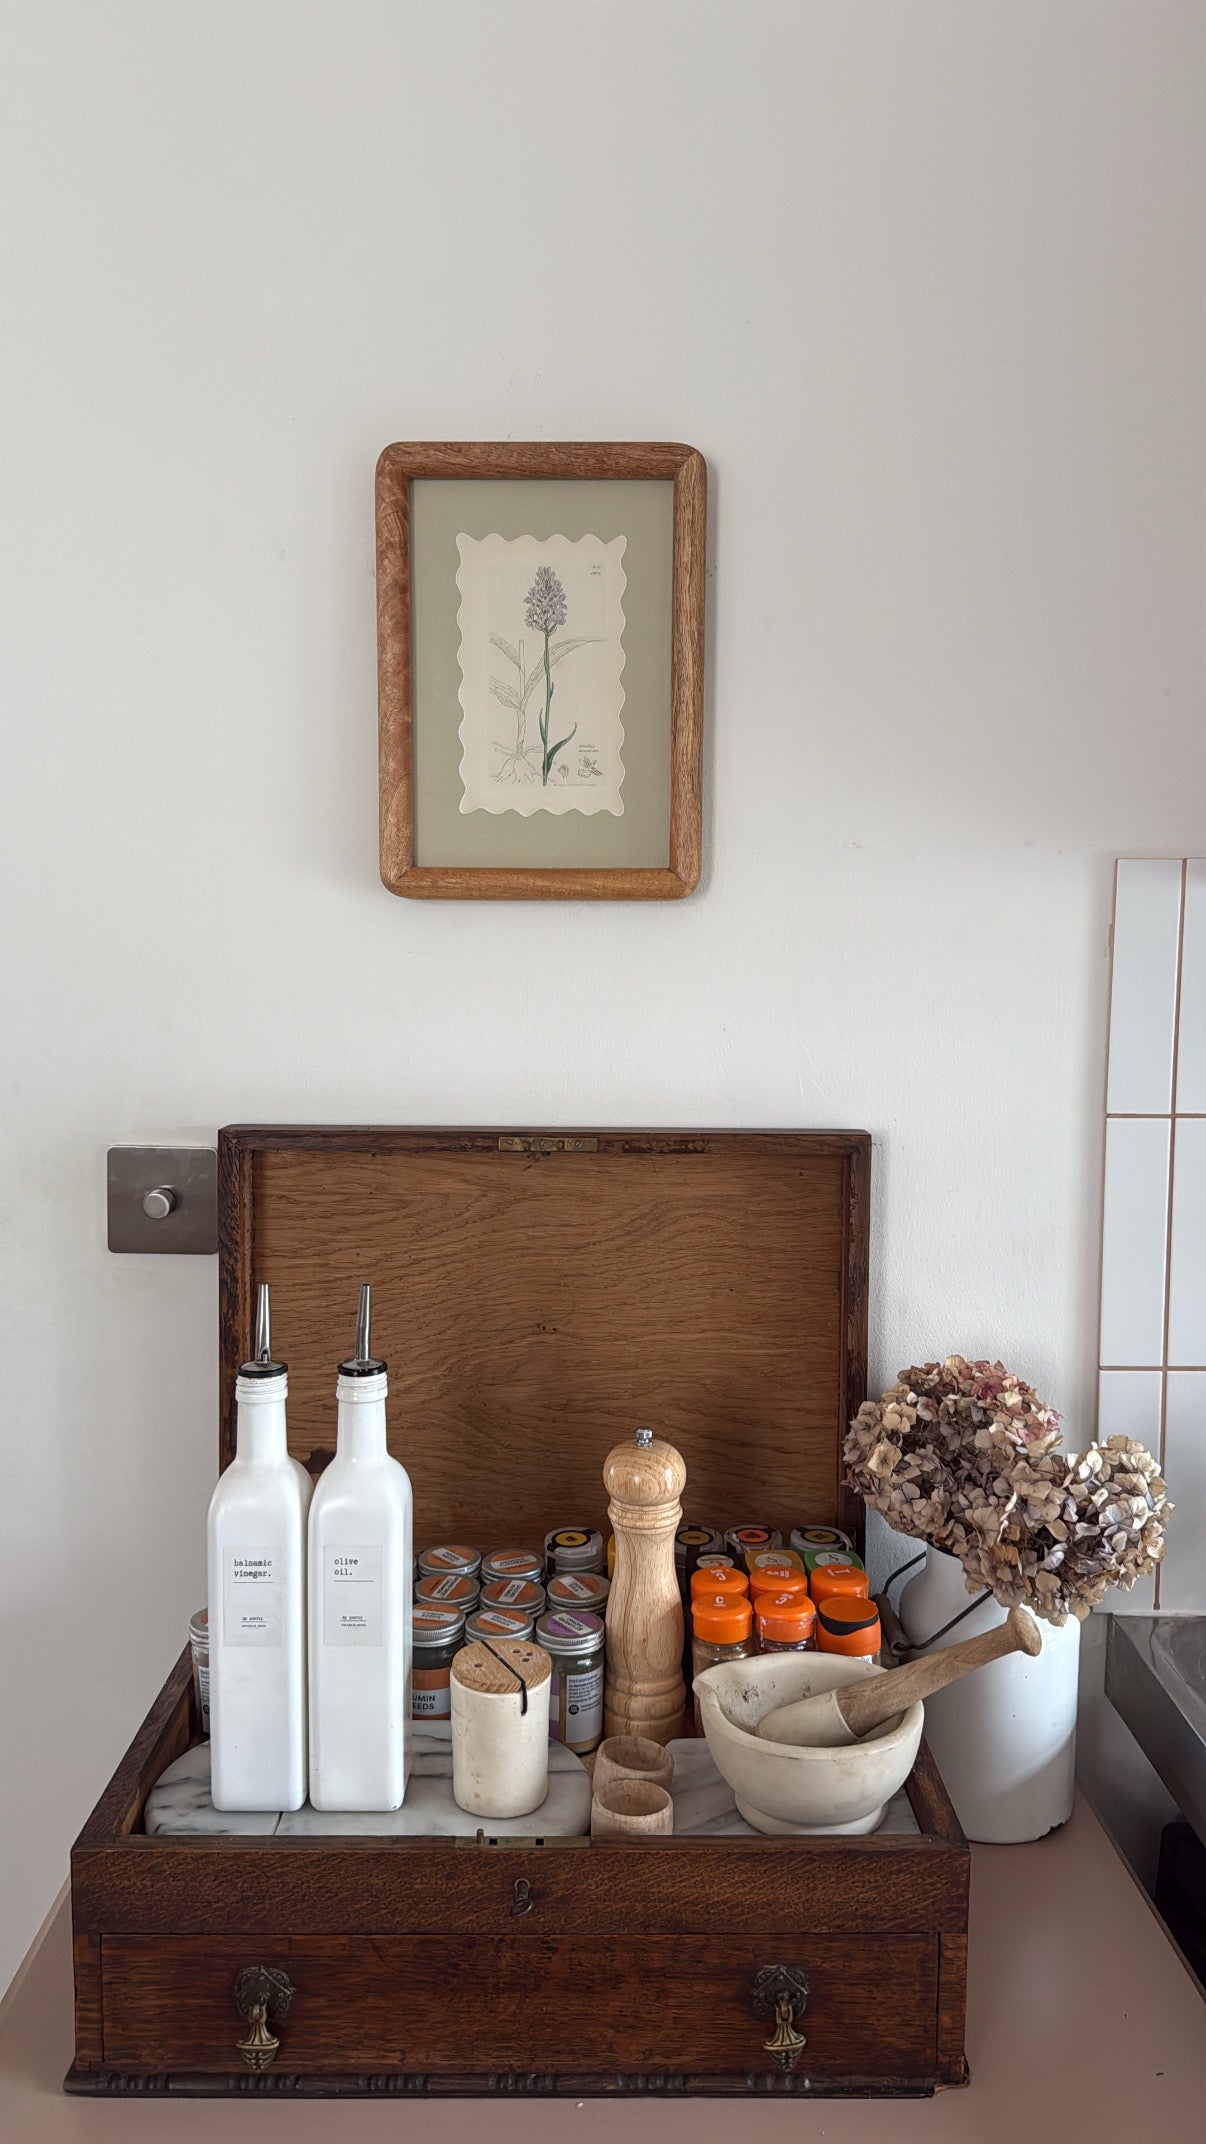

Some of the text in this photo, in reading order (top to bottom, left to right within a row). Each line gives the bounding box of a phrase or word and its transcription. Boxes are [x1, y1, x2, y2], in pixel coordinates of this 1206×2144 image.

[233, 1559, 272, 1567] balsamic
[334, 1557, 359, 1566] olive
[233, 1570, 272, 1579] vinegar.
[334, 1568, 353, 1576] oil.
[412, 1694, 436, 1703] UMIN
[412, 1702, 435, 1710] EEDS
